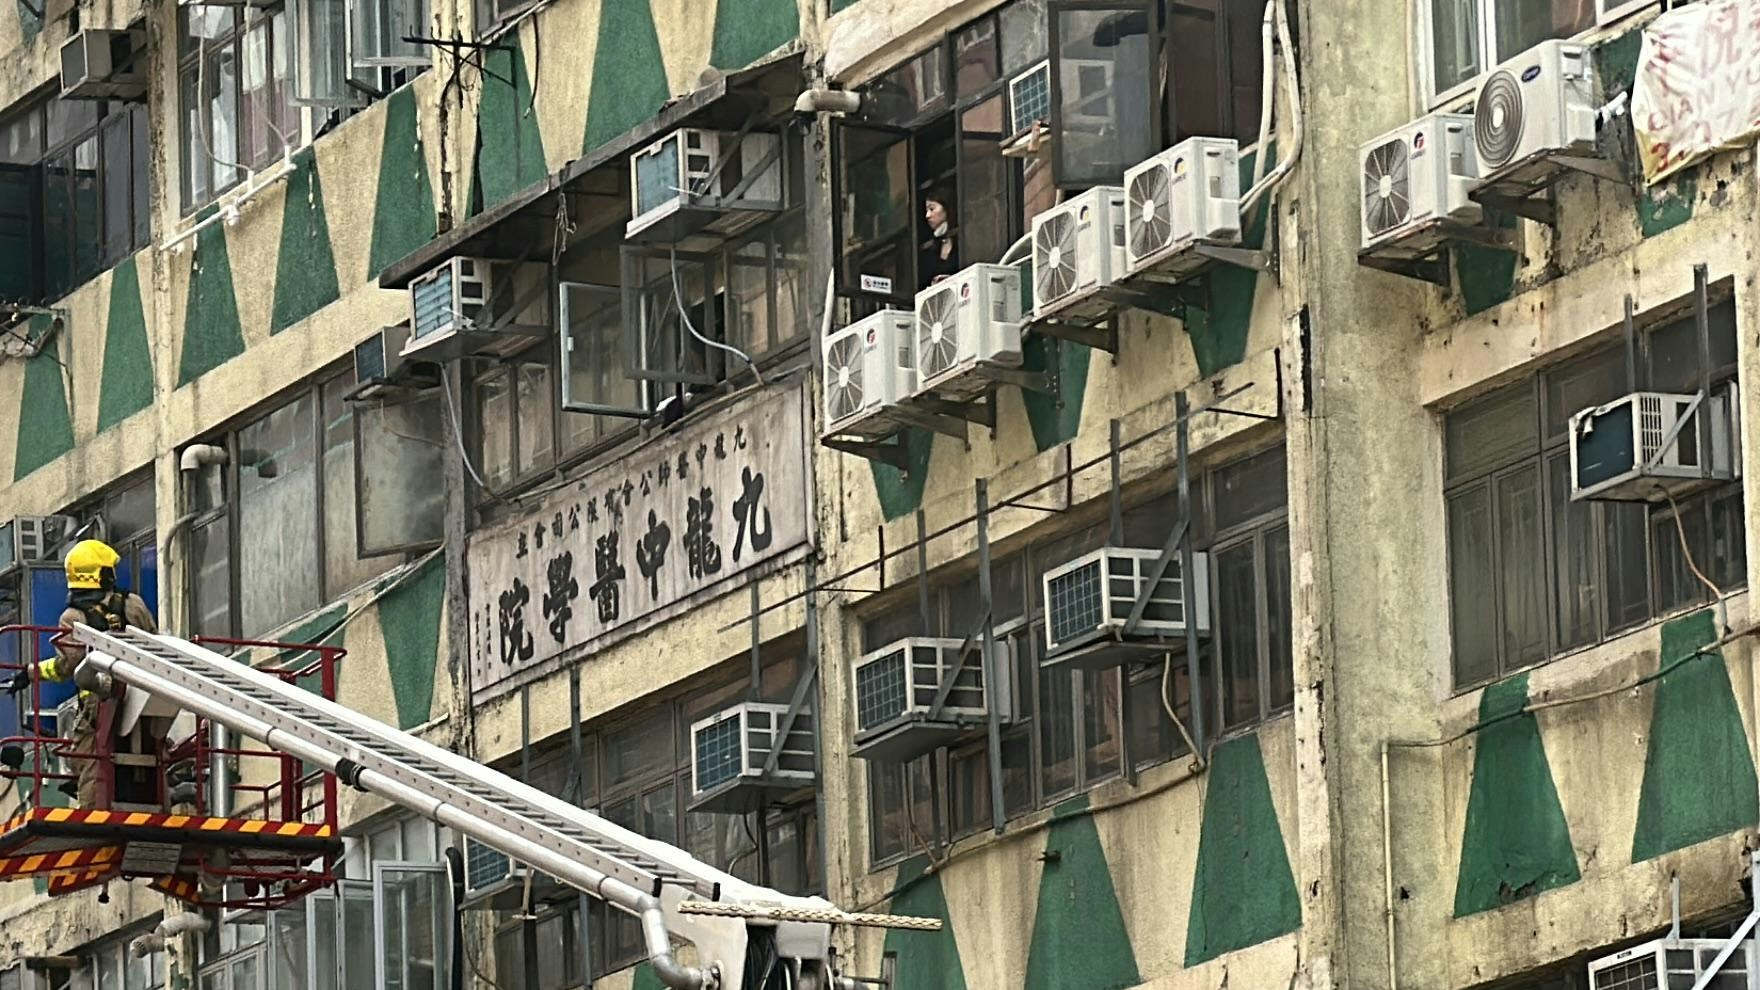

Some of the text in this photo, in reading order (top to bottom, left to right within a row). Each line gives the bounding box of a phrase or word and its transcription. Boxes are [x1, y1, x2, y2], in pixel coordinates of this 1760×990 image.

[498, 465, 773, 667] 九龍中醫學院
